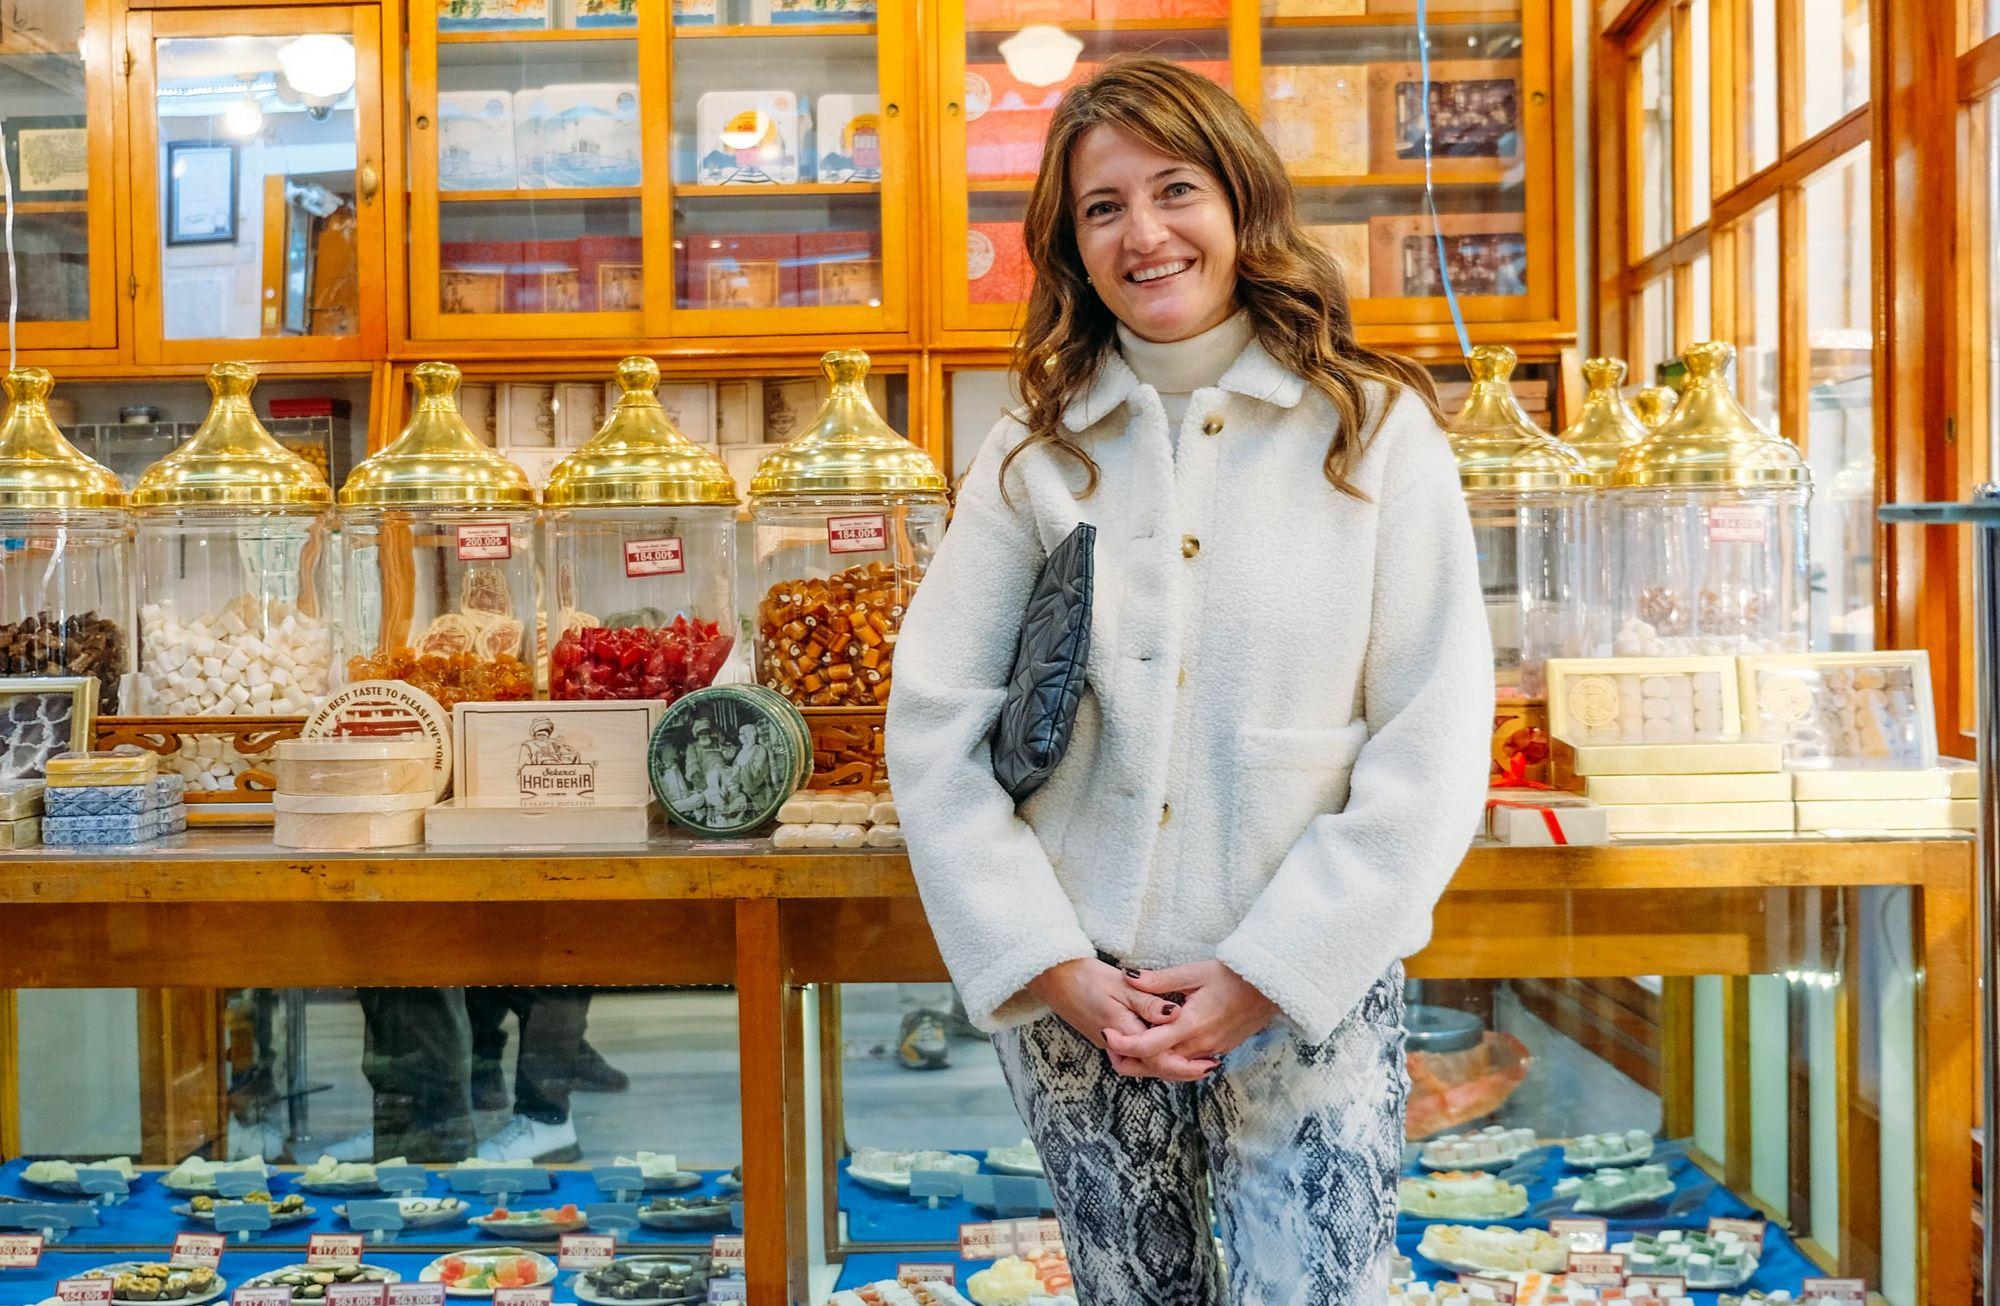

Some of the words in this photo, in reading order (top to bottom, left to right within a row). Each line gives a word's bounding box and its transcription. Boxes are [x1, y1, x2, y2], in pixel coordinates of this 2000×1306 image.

[837, 528, 877, 539] 184.00₺
[465, 537, 503, 547] 200.00₺
[634, 551, 674, 562] 184.00₺
[314, 706, 330, 727] THE
[328, 693, 351, 711] BEST
[353, 686, 383, 698] TASTE
[386, 688, 398, 698] TO
[399, 693, 431, 721] PLEASE
[523, 774, 554, 789] HACI
[556, 773, 592, 789] BEKİR
